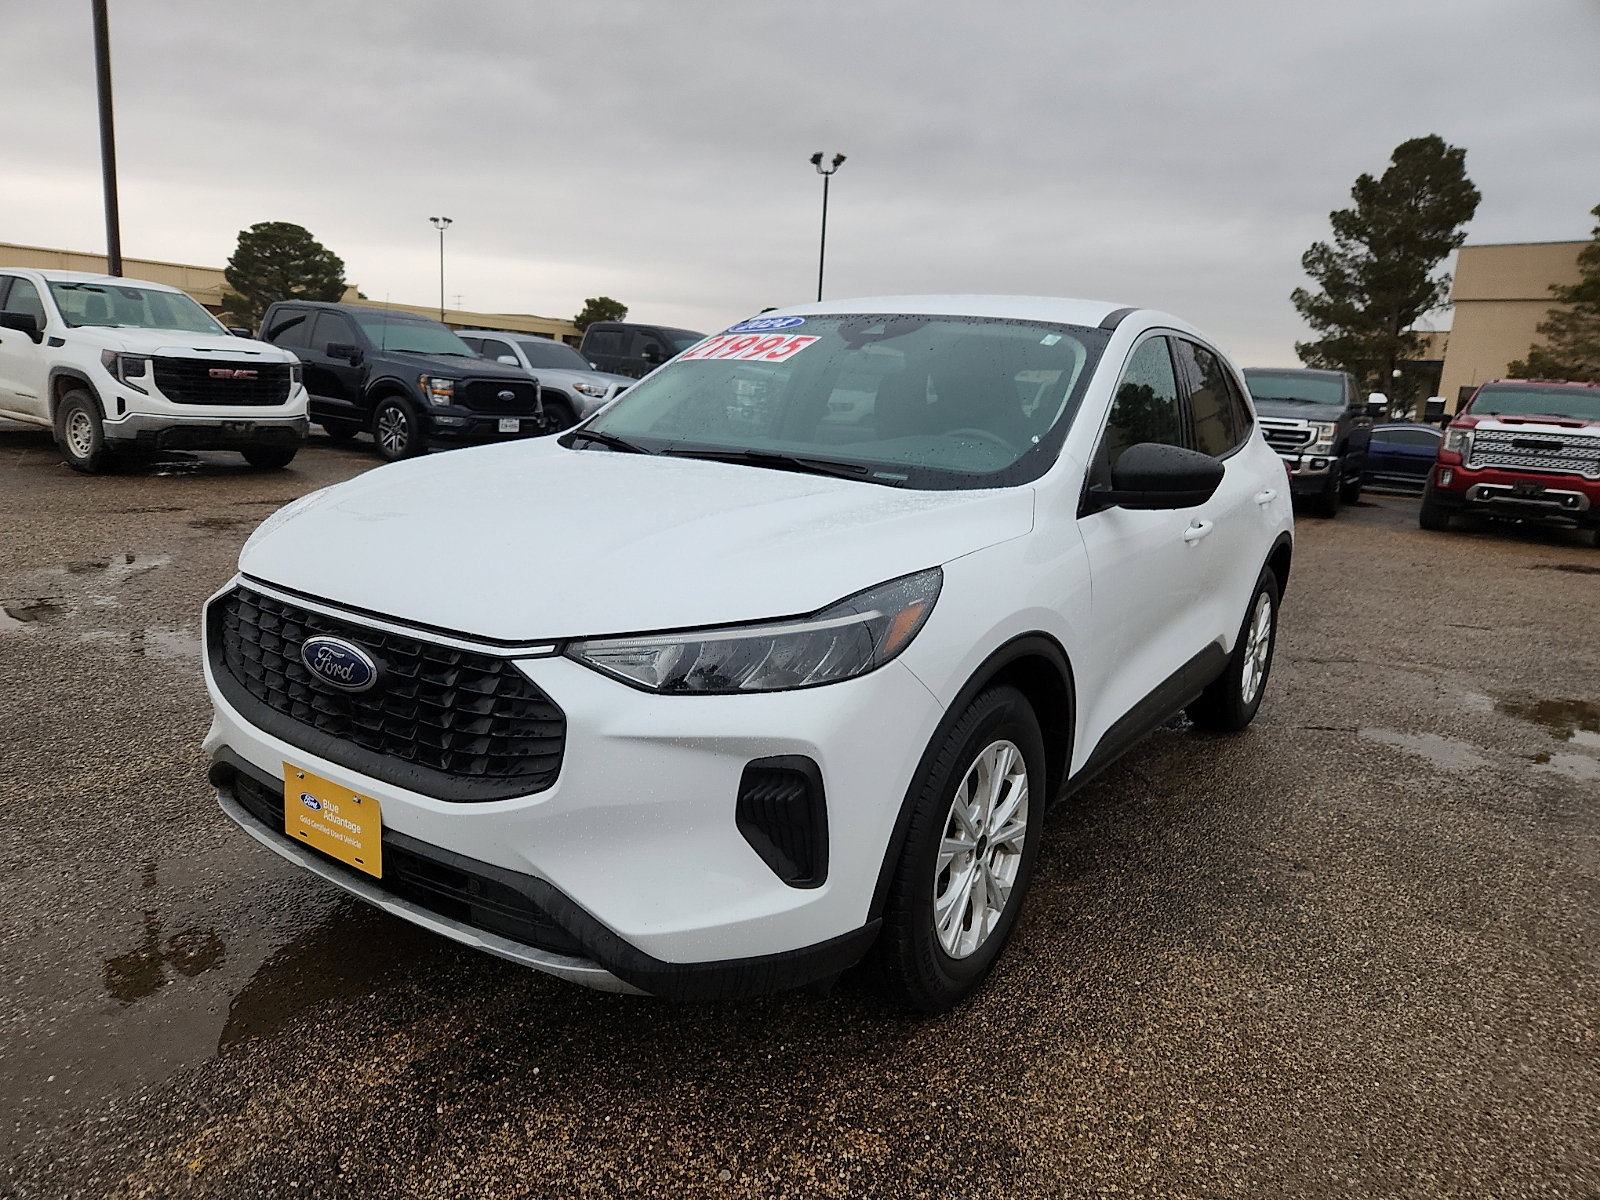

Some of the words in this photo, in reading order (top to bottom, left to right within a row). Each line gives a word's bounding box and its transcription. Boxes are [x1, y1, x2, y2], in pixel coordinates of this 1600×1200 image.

[680, 336, 816, 359] 21995
[209, 368, 259, 380] GMC
[314, 646, 356, 681] Ford
[322, 798, 339, 813] Blue
[323, 810, 361, 834] Advantage
